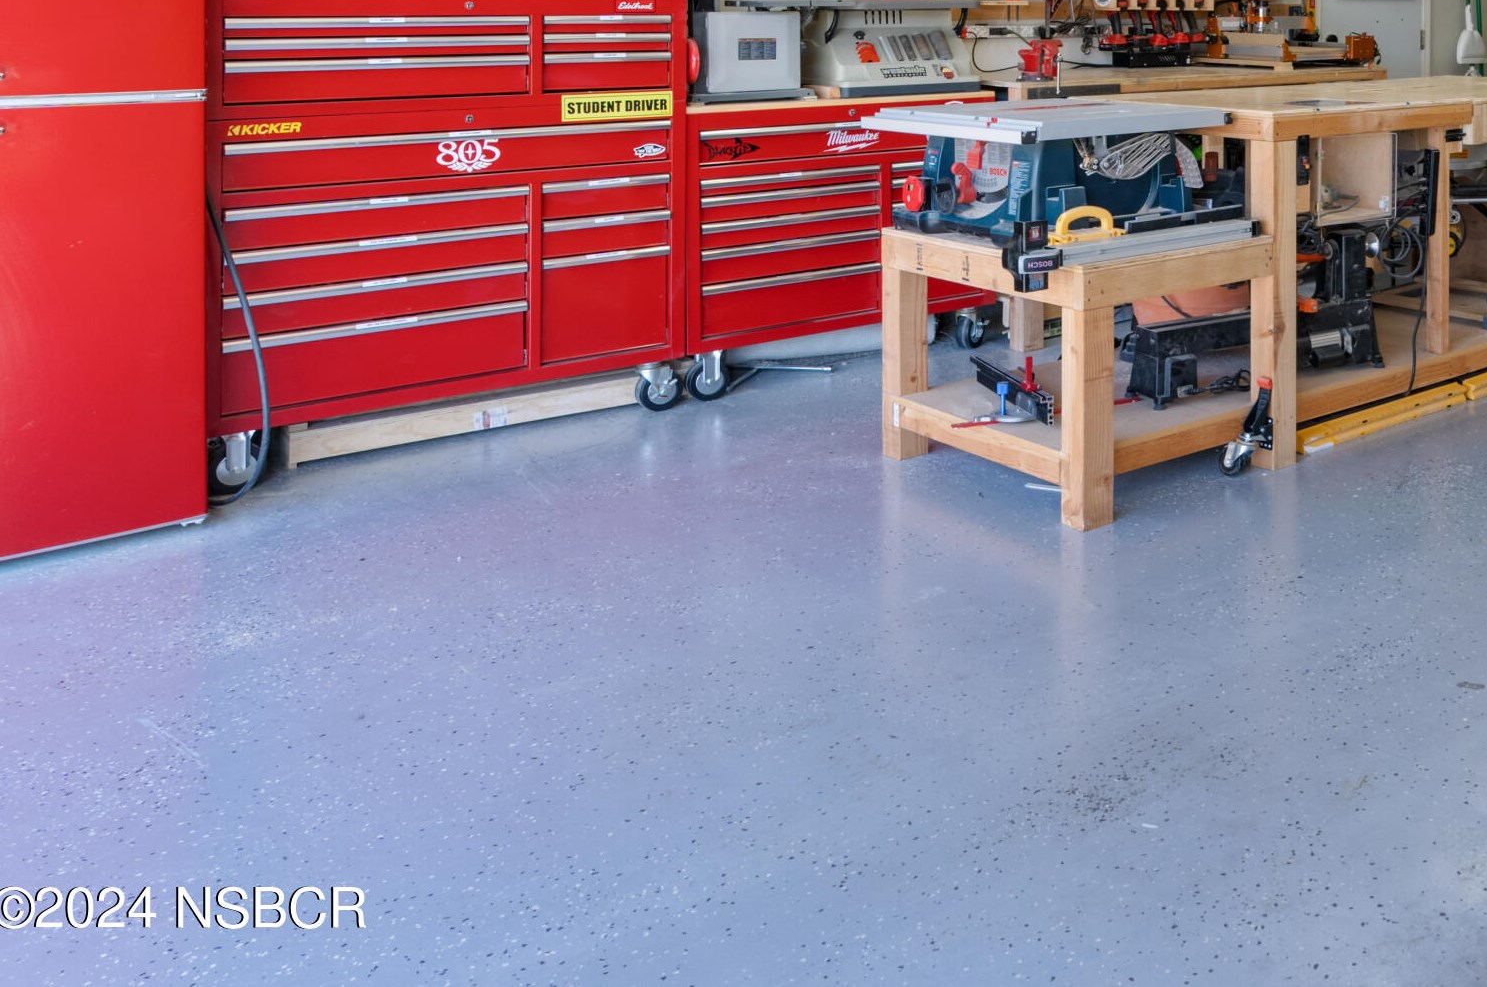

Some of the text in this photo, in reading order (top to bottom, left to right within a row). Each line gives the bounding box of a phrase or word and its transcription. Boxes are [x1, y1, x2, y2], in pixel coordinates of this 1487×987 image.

[618, 1, 653, 10] Edelbrock
[567, 98, 668, 115] STUDENT DRIVER
[240, 121, 303, 136] KICKER
[825, 129, 880, 147] Milwaukee
[436, 138, 501, 166] 805
[989, 167, 1008, 176] BOSCH
[1027, 259, 1053, 269] BOSCH
